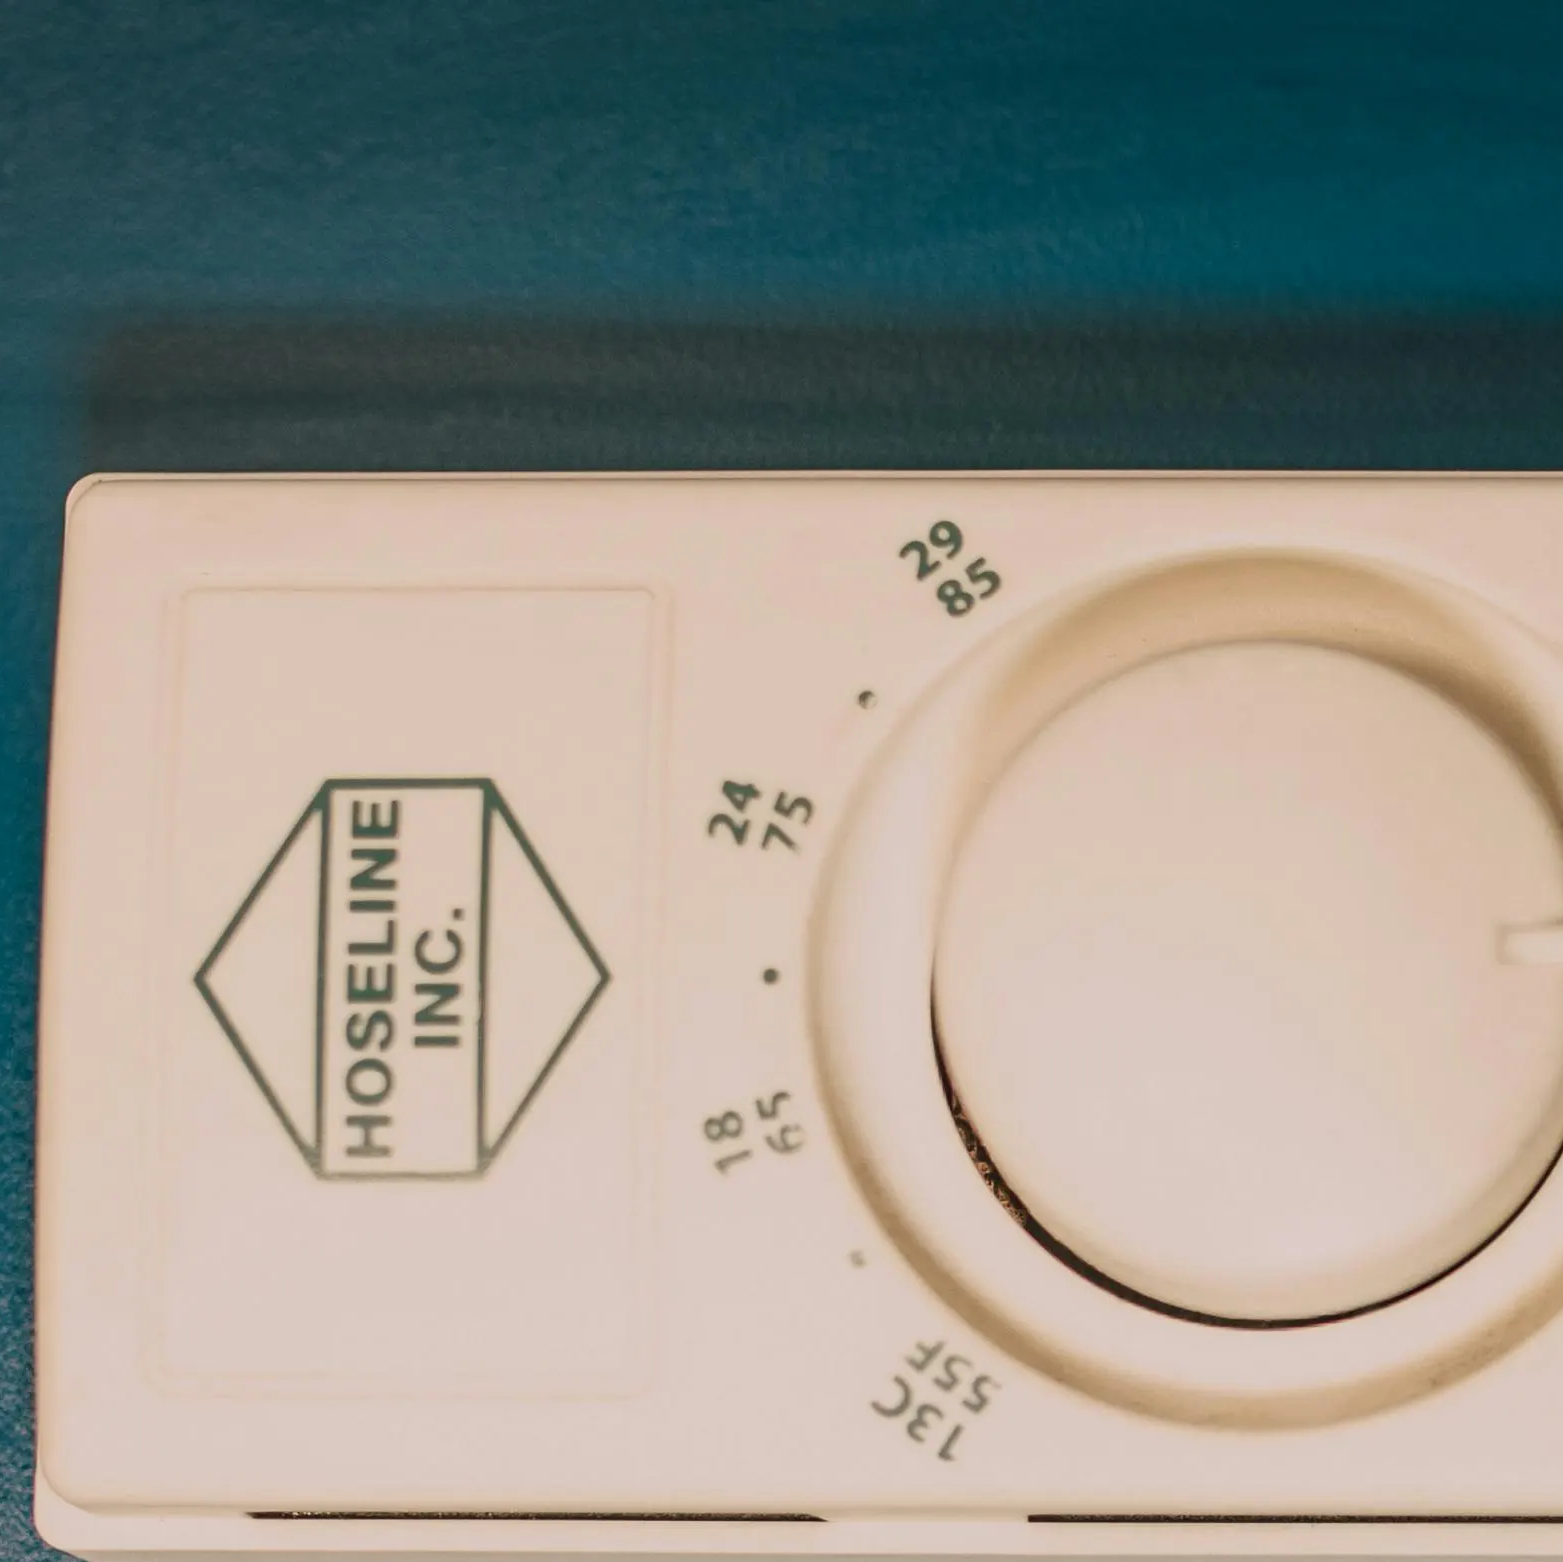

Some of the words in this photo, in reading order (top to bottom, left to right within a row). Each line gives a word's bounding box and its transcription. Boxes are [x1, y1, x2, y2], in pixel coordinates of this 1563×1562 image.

[898, 520, 964, 582] 29
[936, 557, 1002, 618] 85
[707, 779, 762, 846] 24
[761, 790, 815, 854] 75
[344, 799, 401, 1158] HOSELINE
[414, 907, 465, 1048] INC.
[703, 1110, 753, 1175] 18
[755, 1091, 805, 1155] 65
[904, 1341, 1002, 1414] 55F
[870, 1375, 964, 1462] 13C
